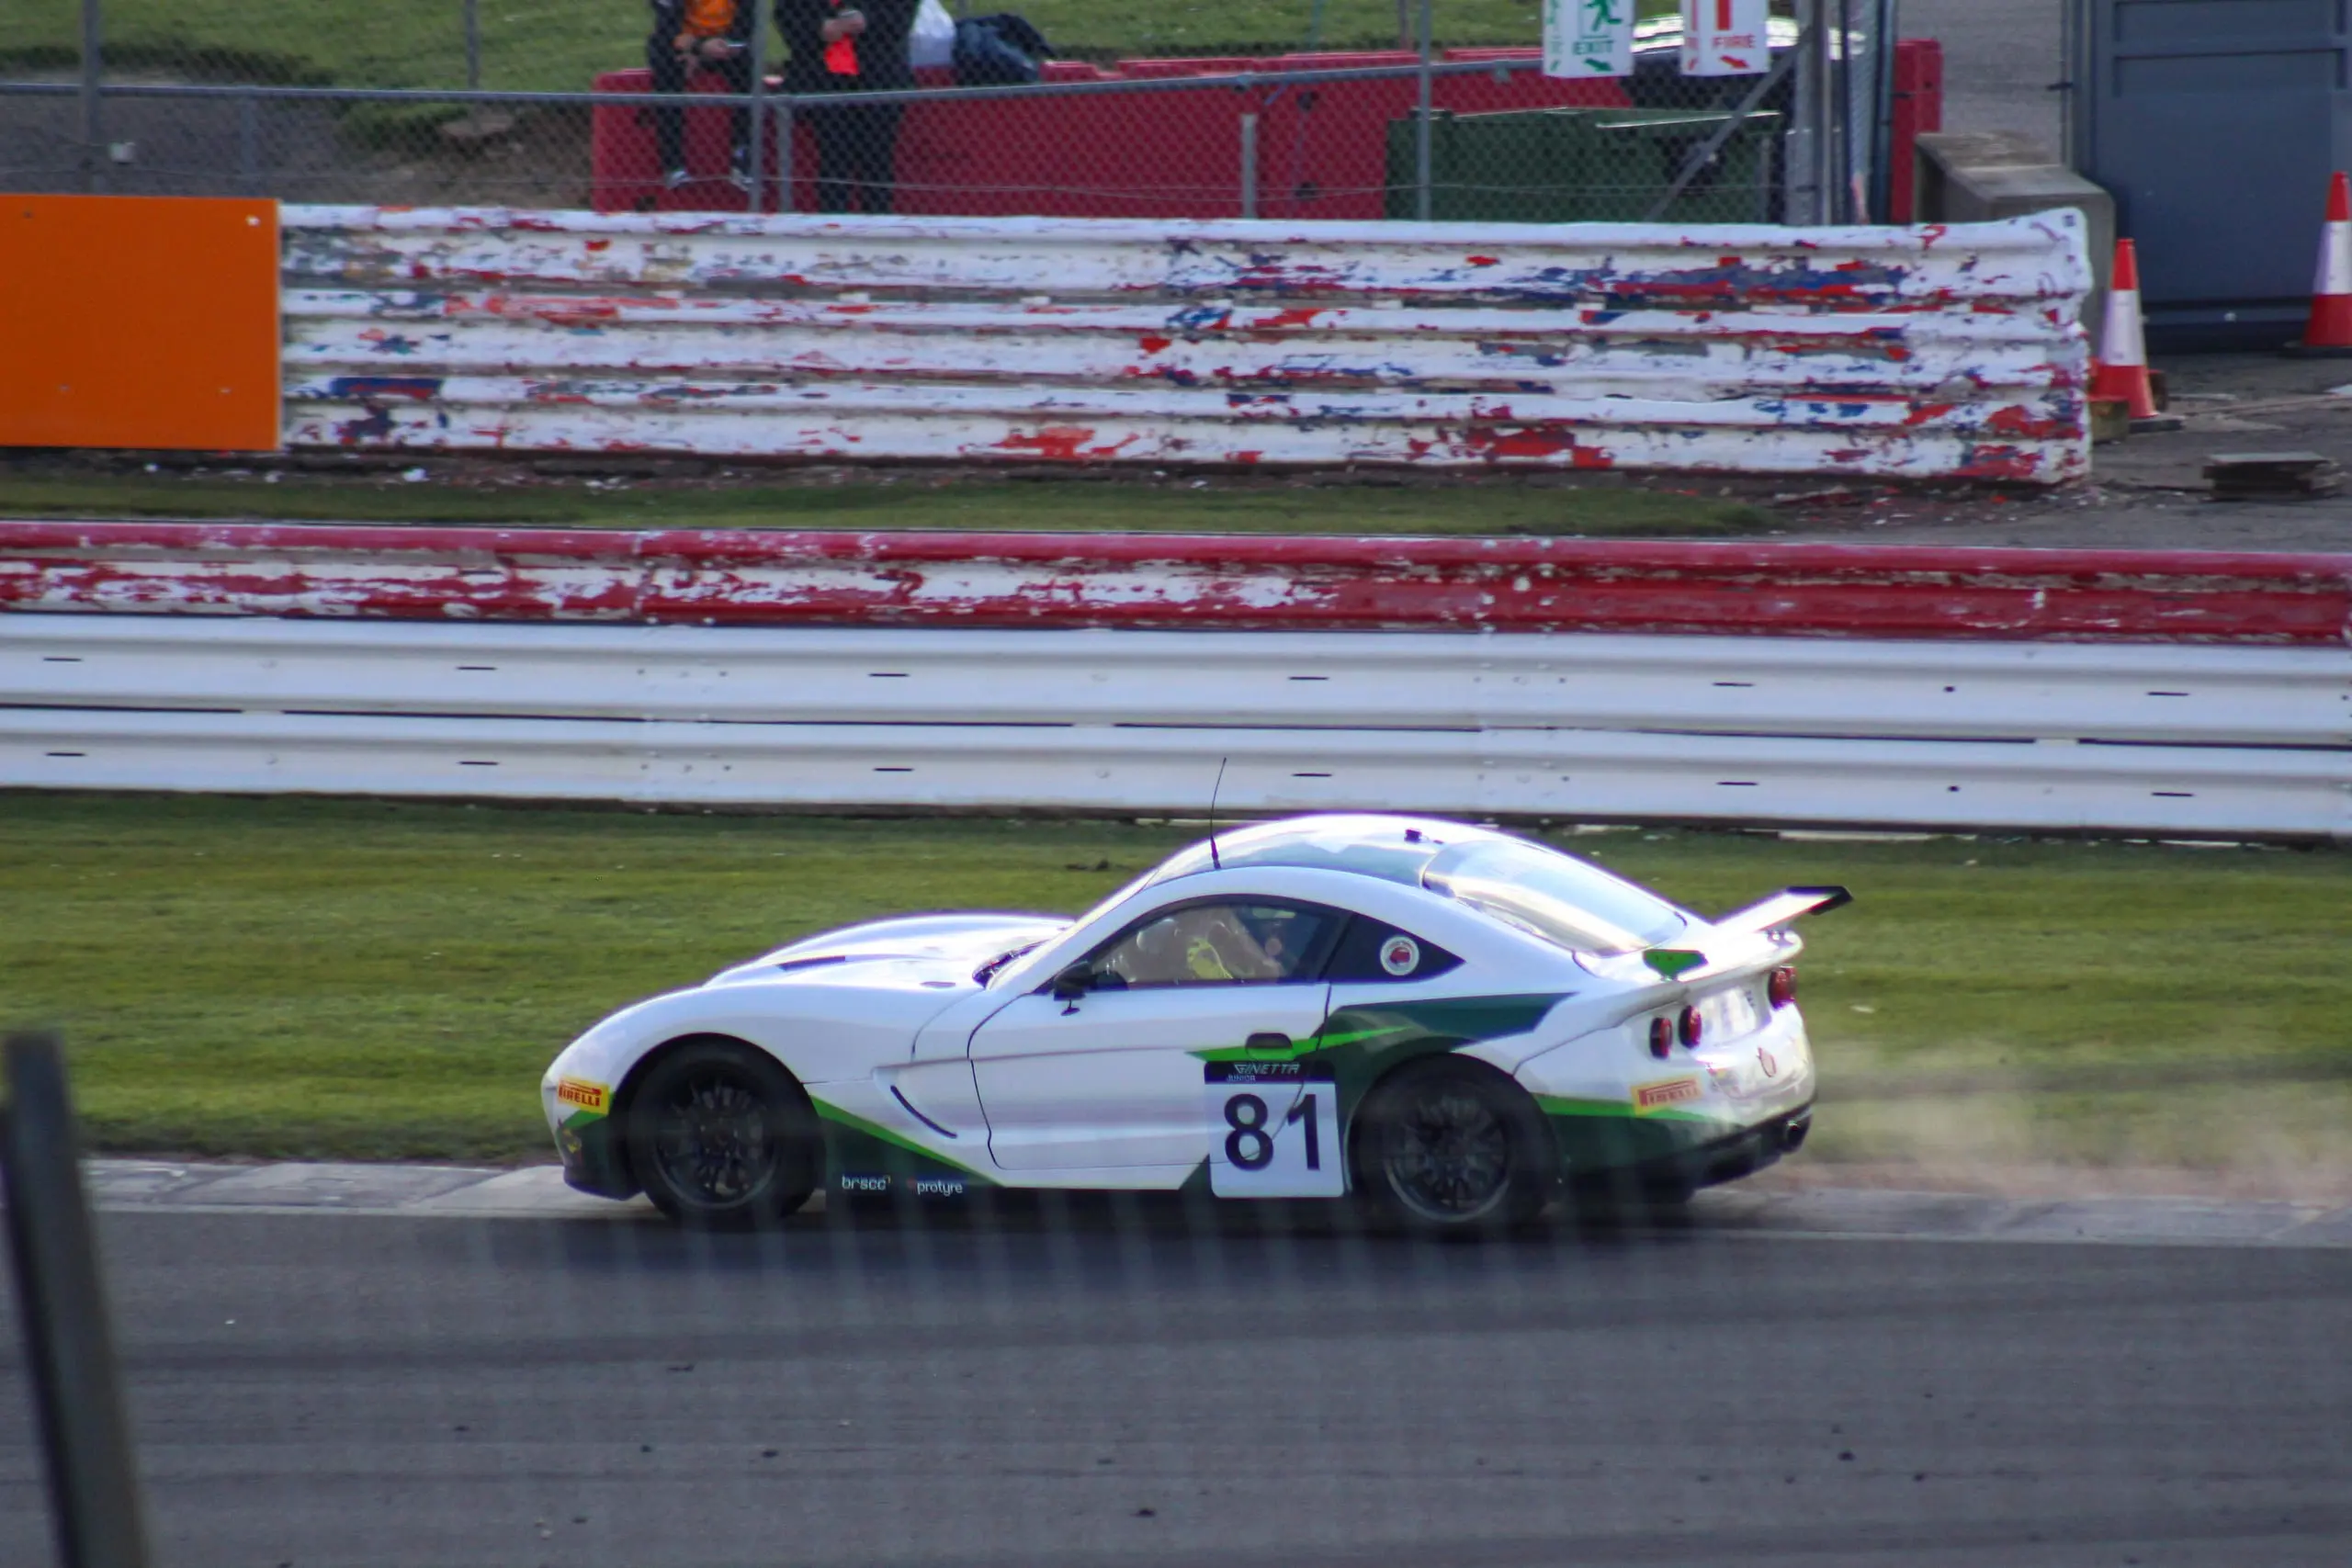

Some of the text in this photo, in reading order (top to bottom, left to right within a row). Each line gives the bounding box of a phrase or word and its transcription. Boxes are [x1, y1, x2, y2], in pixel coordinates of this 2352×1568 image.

[1572, 39, 1613, 55] EXIT
[1712, 35, 1755, 50] FIRE
[1234, 1062, 1301, 1076] GINETTA
[558, 1080, 603, 1108] PIRELLI
[1224, 1093, 1321, 1172] 81
[917, 1179, 964, 1197] protyre
